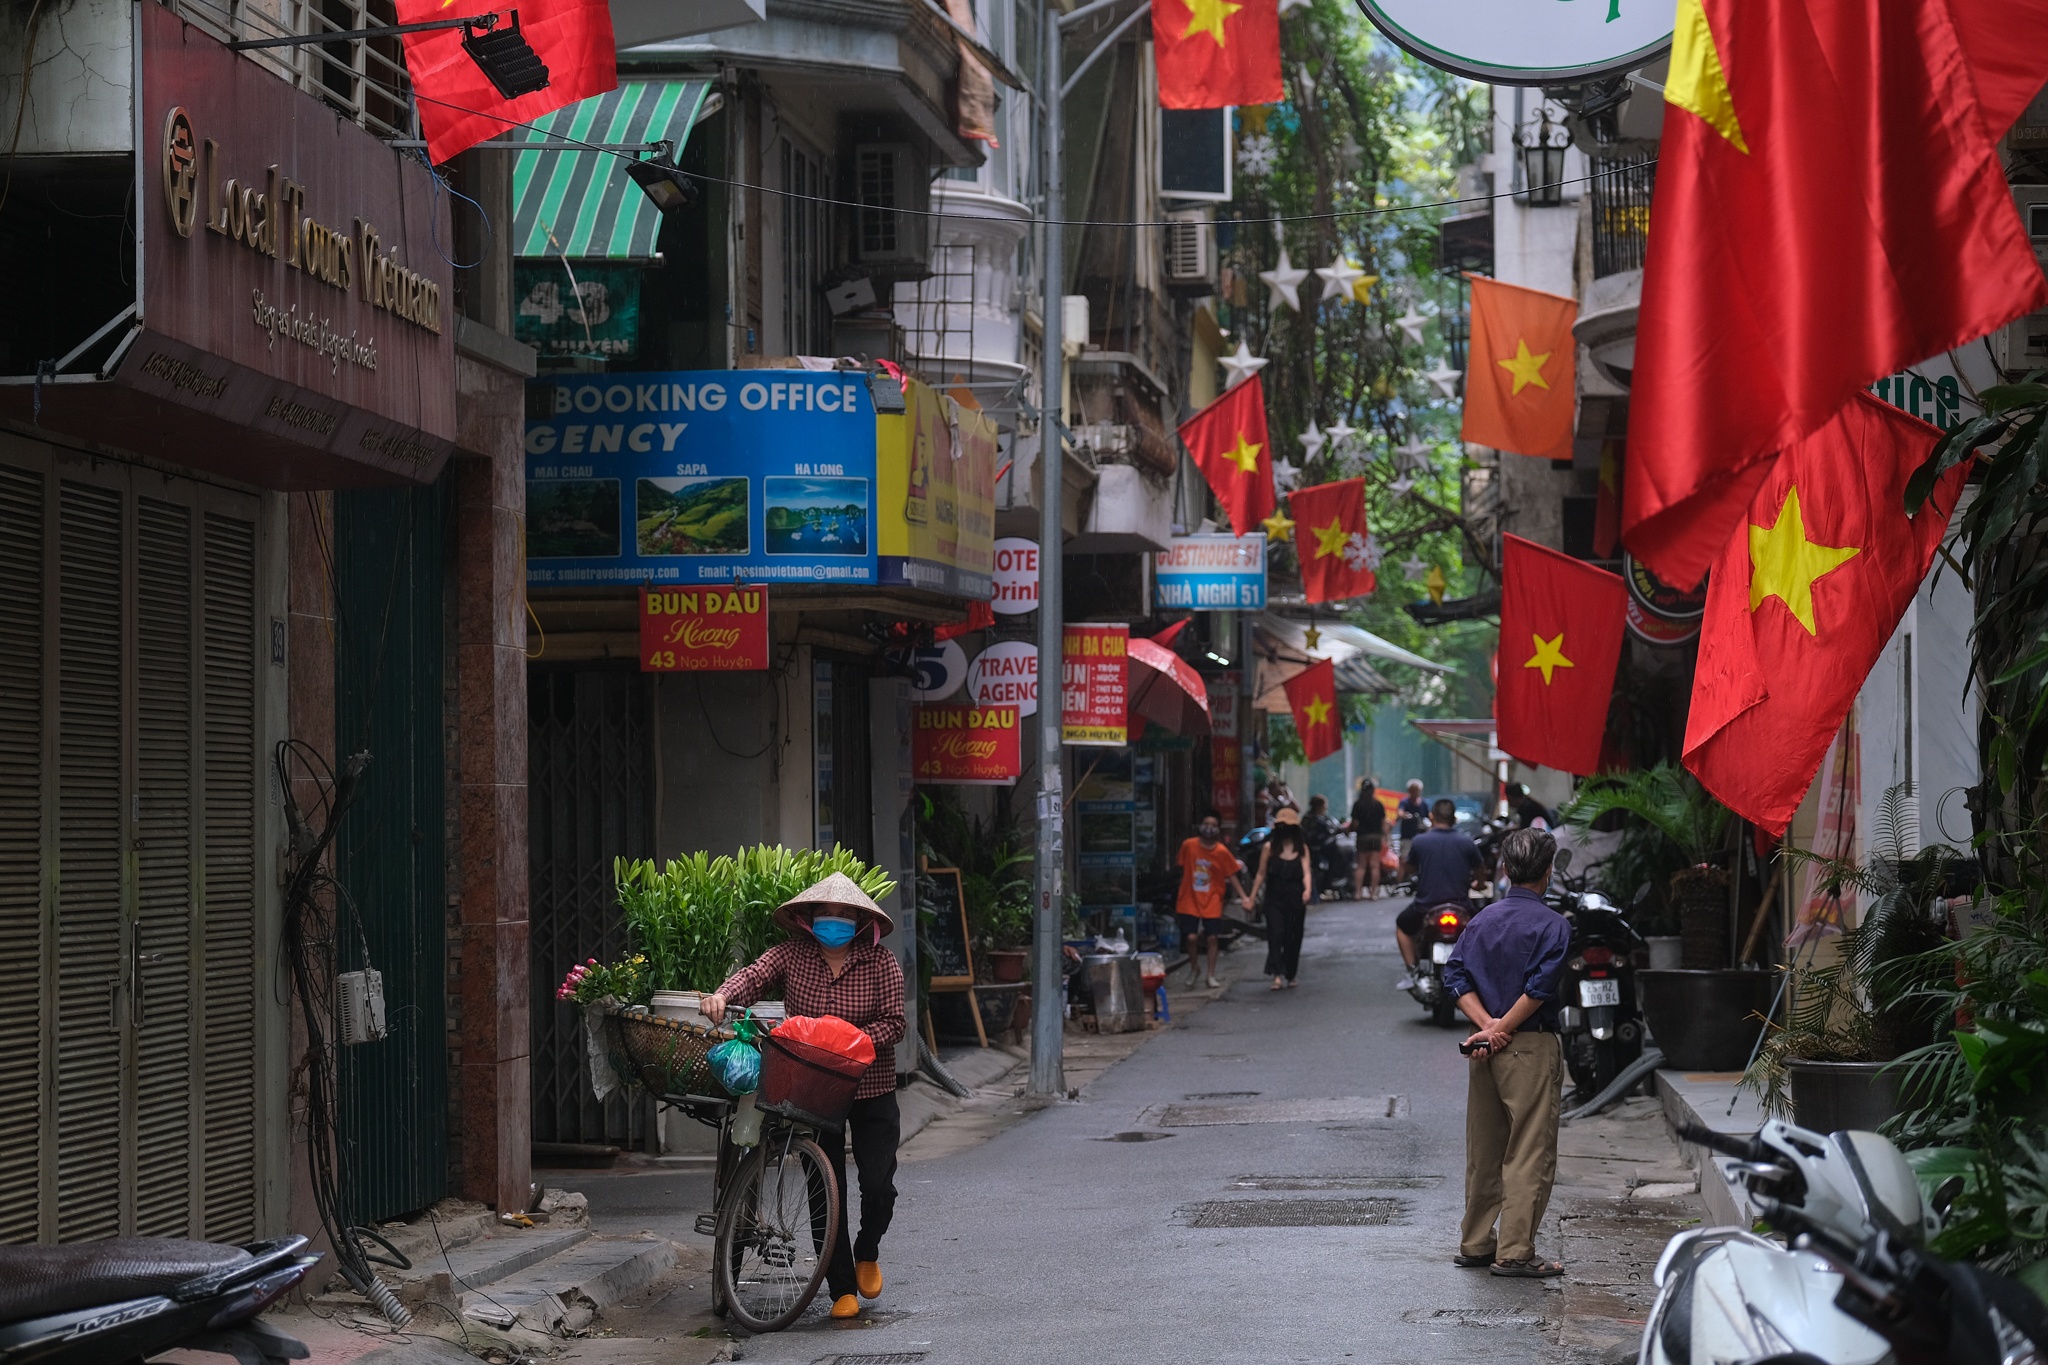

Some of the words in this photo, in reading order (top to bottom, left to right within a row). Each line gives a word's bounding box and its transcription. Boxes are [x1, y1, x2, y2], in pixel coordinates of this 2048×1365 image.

[205, 138, 280, 260] Local
[282, 177, 353, 292] Tours
[354, 217, 442, 338] Vietnam
[520, 281, 609, 325] 43
[253, 288, 276, 353] Stay
[279, 310, 290, 335] as
[319, 318, 340, 378] Play
[340, 337, 351, 361] as
[351, 329, 378, 371] locals
[173, 362, 196, 391] Ngo
[555, 382, 727, 414] BOOKING
[740, 382, 857, 413] OFFICE
[526, 423, 689, 455] GENCY
[534, 466, 559, 478] MAI
[561, 465, 593, 478] CHAU
[676, 464, 708, 477] SAPA
[795, 464, 812, 477] HA
[813, 463, 844, 477] LONG
[698, 565, 730, 579] Email:
[1159, 579, 1193, 605] NHÀ
[1197, 576, 1237, 605] NGHỈ
[1241, 584, 1259, 605] 51
[1102, 635, 1126, 657] CUA
[649, 651, 676, 668] 43
[713, 655, 753, 671] Huyện
[979, 656, 1038, 677] TRAVE
[920, 760, 942, 774] 43
